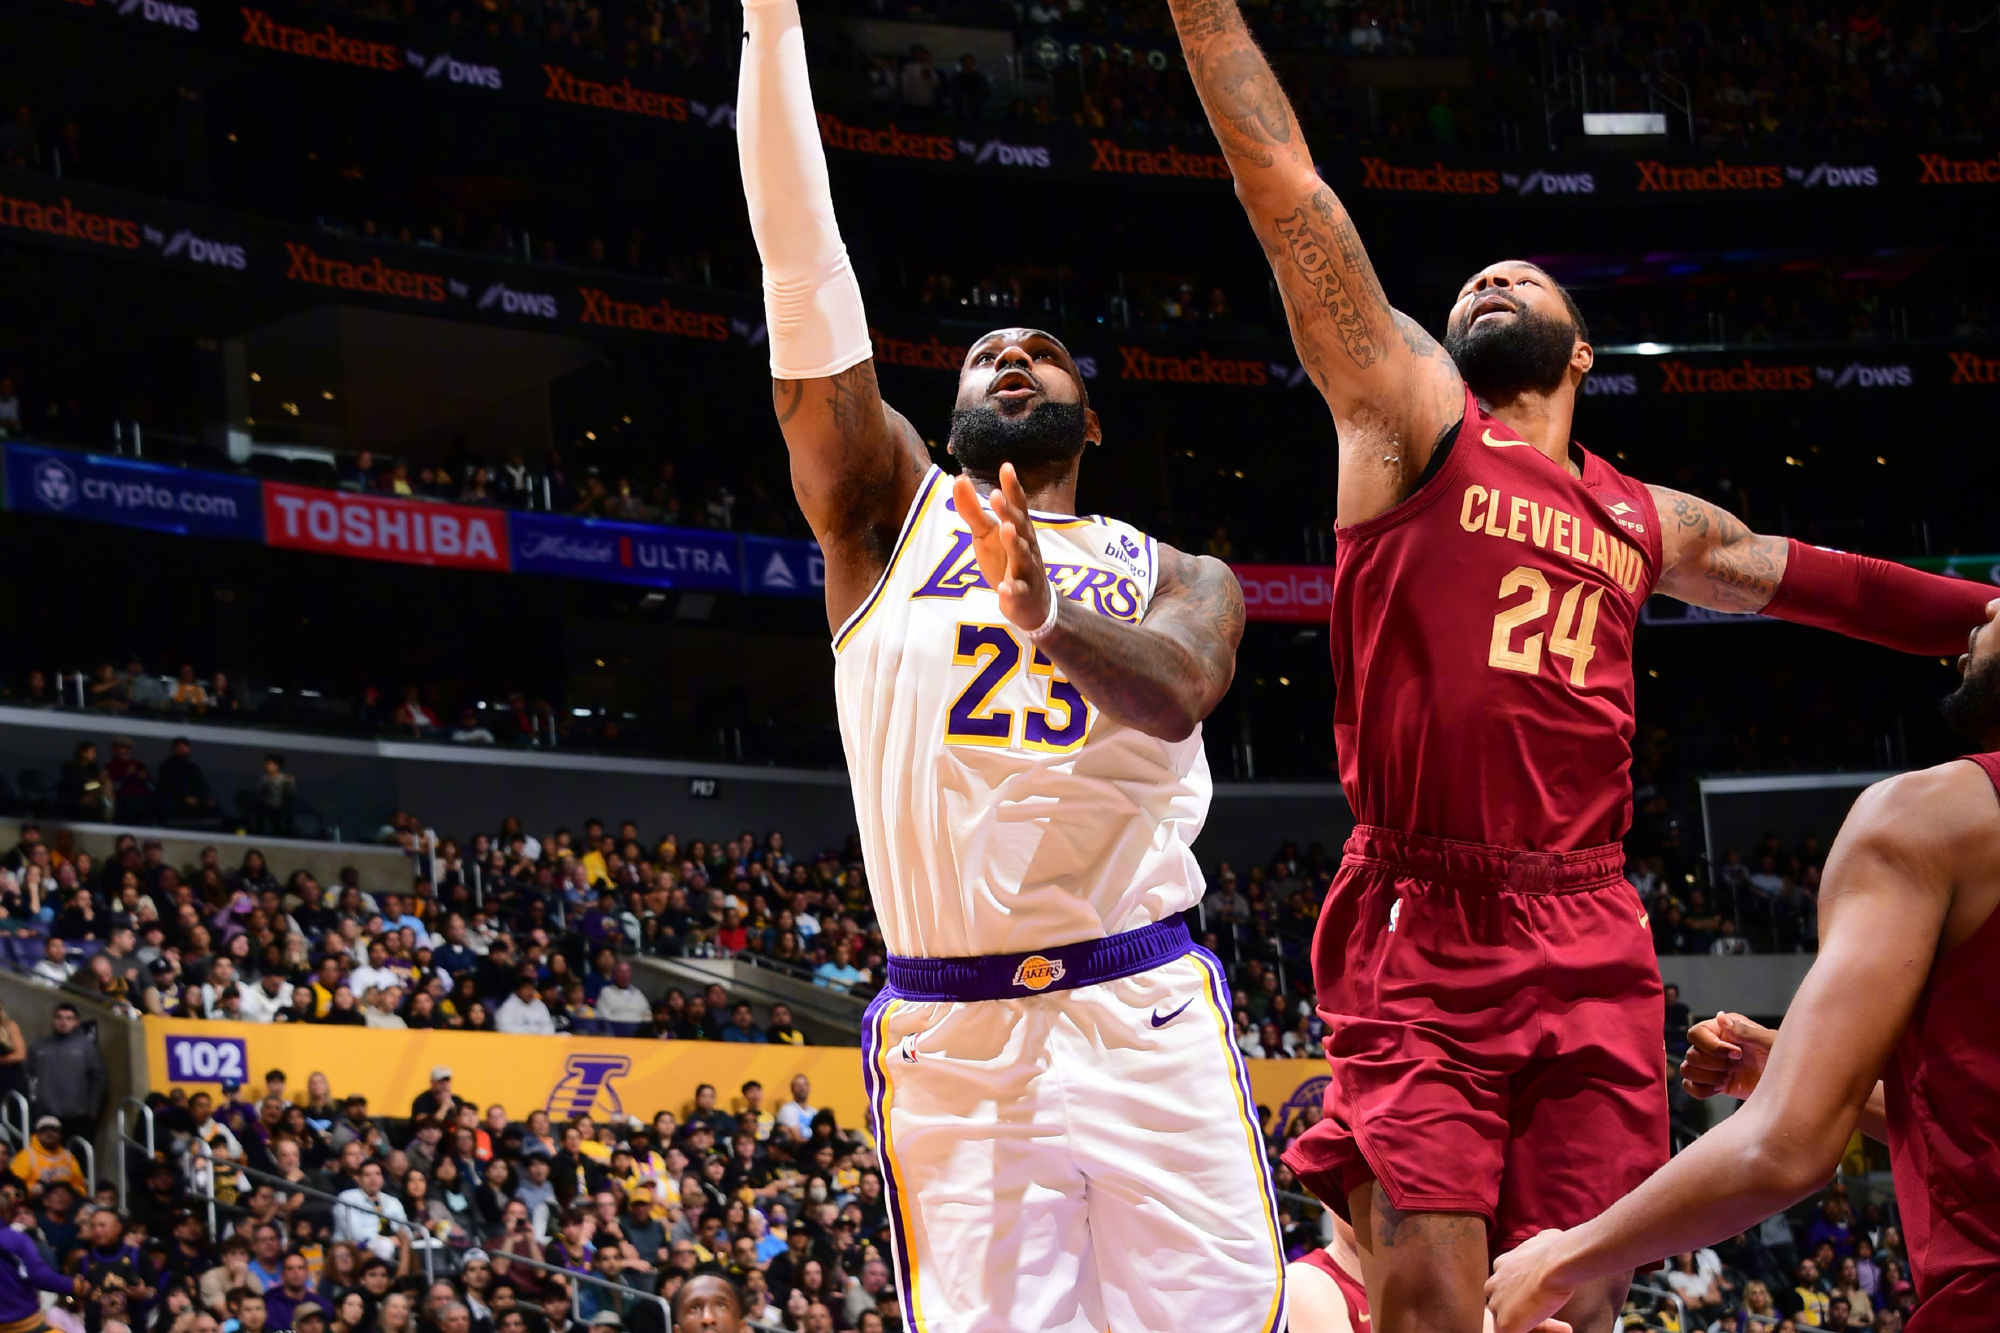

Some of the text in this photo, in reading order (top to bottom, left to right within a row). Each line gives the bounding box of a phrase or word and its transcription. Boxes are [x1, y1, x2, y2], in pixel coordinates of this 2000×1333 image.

[239, 6, 402, 71] Xtrackers
[542, 63, 688, 122] Xtrackers
[1089, 138, 1232, 180] Xtrackers
[1360, 156, 1500, 195] Xtrackers
[1635, 157, 1784, 191] Xtrackers
[1916, 151, 2000, 184] Xtrac
[283, 240, 446, 303] Xtrackers
[577, 285, 730, 341] Xtrackers
[869, 326, 966, 371] tracke
[1117, 345, 1268, 386] Xtrackers
[1657, 357, 1814, 394] Xtrackers
[81, 476, 238, 519] crypto.com
[274, 493, 499, 561] TOSHIBA
[1459, 484, 1643, 594] CLEVELAND
[637, 542, 732, 576] ULTRA
[908, 527, 1141, 625] LAERS
[1105, 541, 1146, 578] bibigo
[1488, 565, 1603, 687] 24
[944, 621, 1091, 753] 23
[1013, 965, 1062, 984] LAKERS
[174, 1040, 243, 1077] 102
